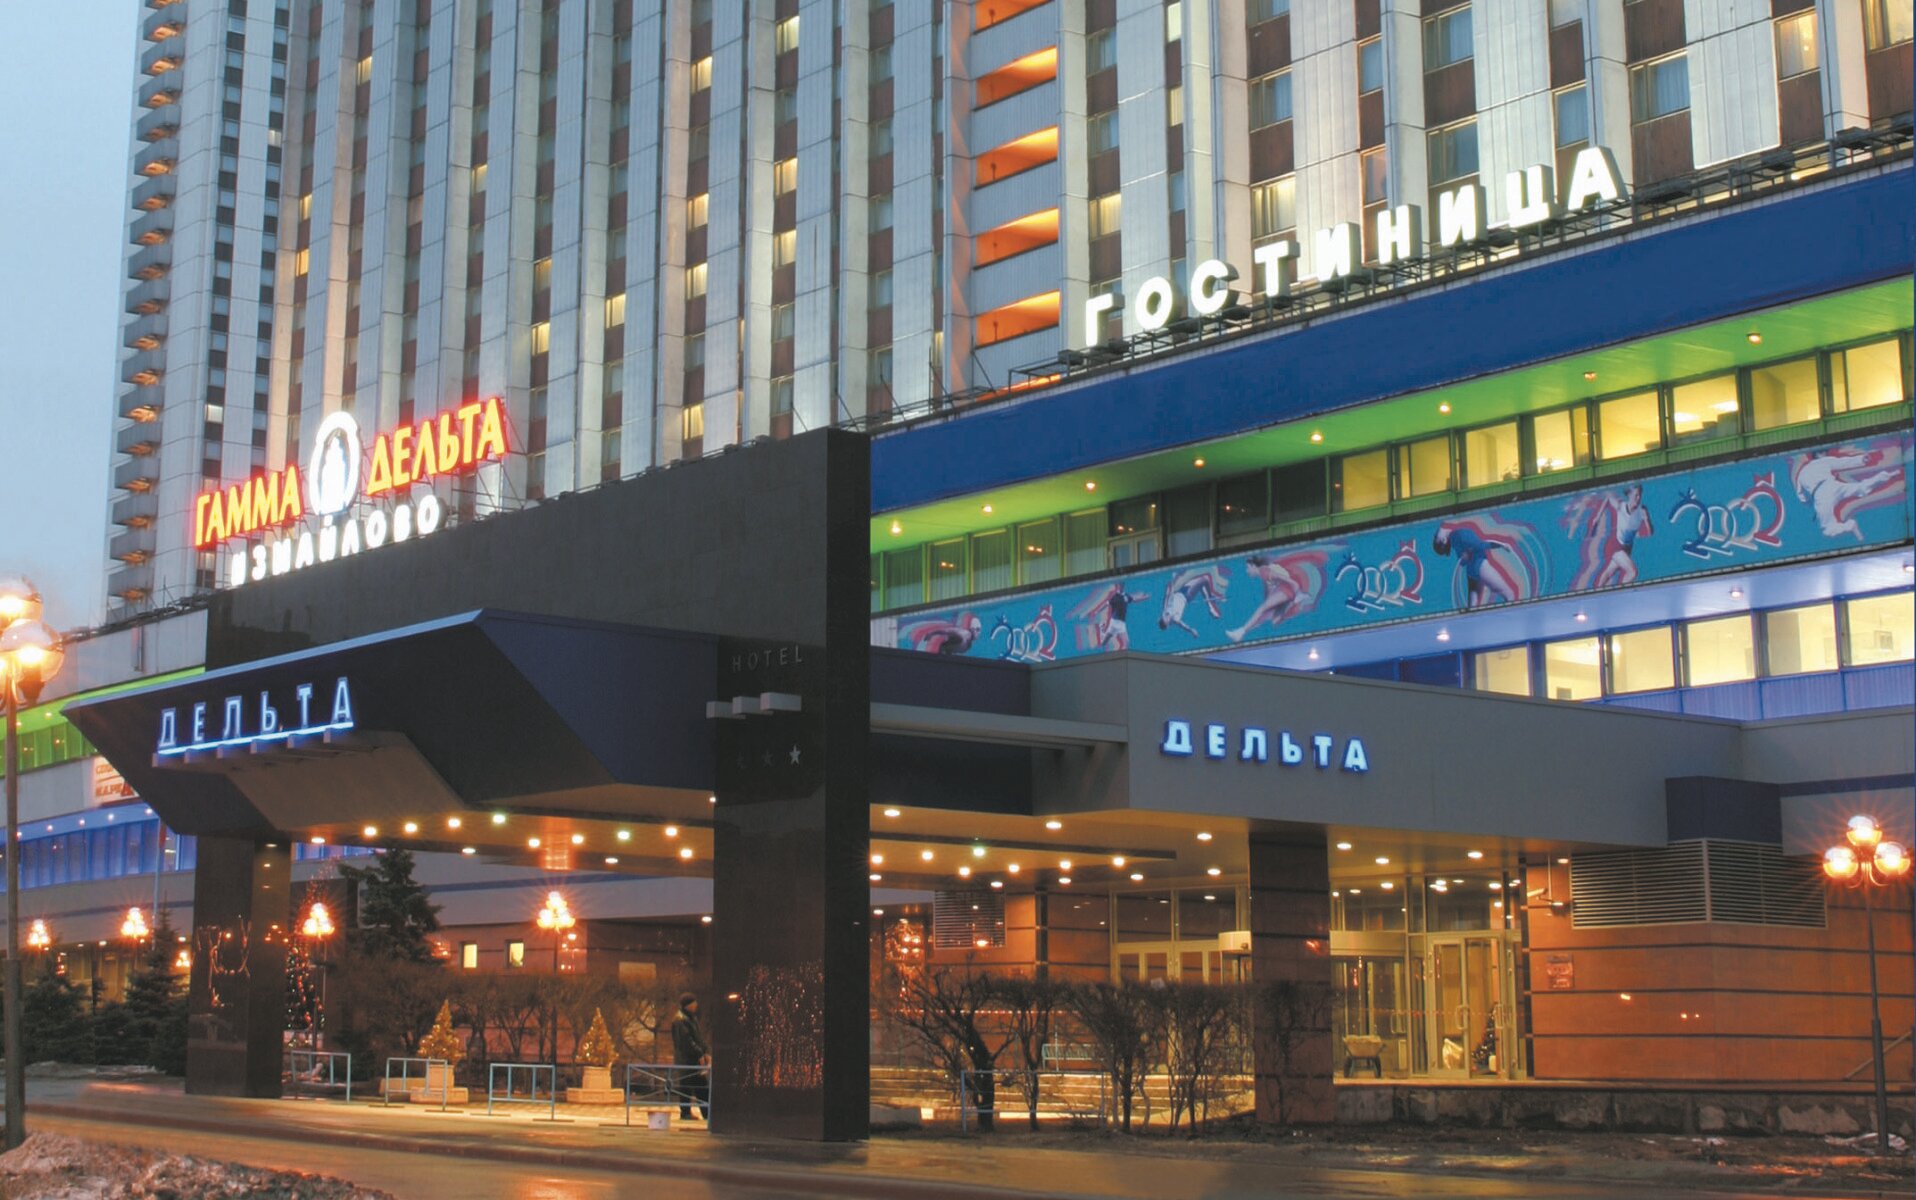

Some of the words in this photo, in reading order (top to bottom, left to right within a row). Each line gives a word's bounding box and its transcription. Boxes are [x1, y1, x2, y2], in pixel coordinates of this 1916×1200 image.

[1085, 146, 1627, 348] ГОСТИНИЦА
[194, 464, 302, 547] ГАММА
[366, 398, 506, 497] ДЕЛЬТА
[230, 494, 440, 587] ИЗМАЙЛОВО
[731, 644, 802, 672] HOTEL
[158, 676, 352, 748] ДЕЛЬТА
[1161, 719, 1369, 772] ДЕЛЬТА
